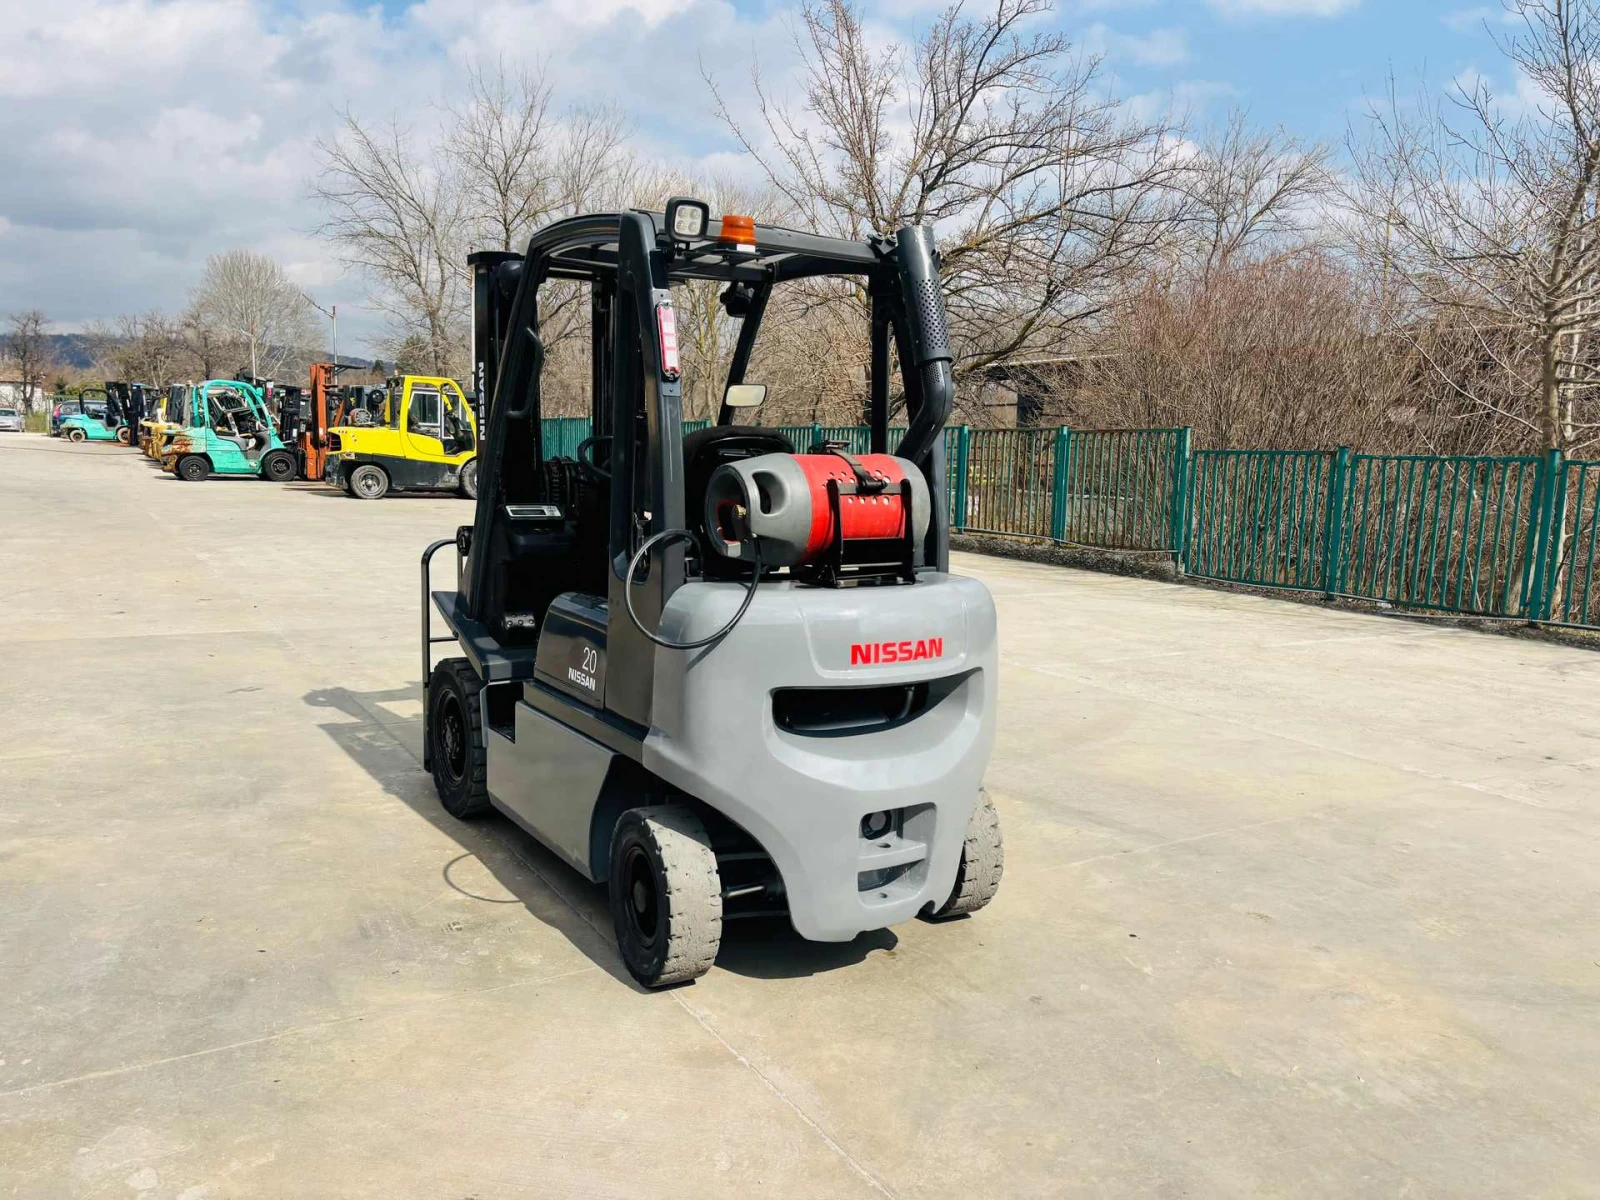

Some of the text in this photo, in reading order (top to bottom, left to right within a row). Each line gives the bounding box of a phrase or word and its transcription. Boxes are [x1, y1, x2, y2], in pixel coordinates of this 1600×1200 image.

[582, 646, 597, 674] 20
[850, 637, 943, 666] NISSAN
[568, 667, 596, 691] NISSAN
